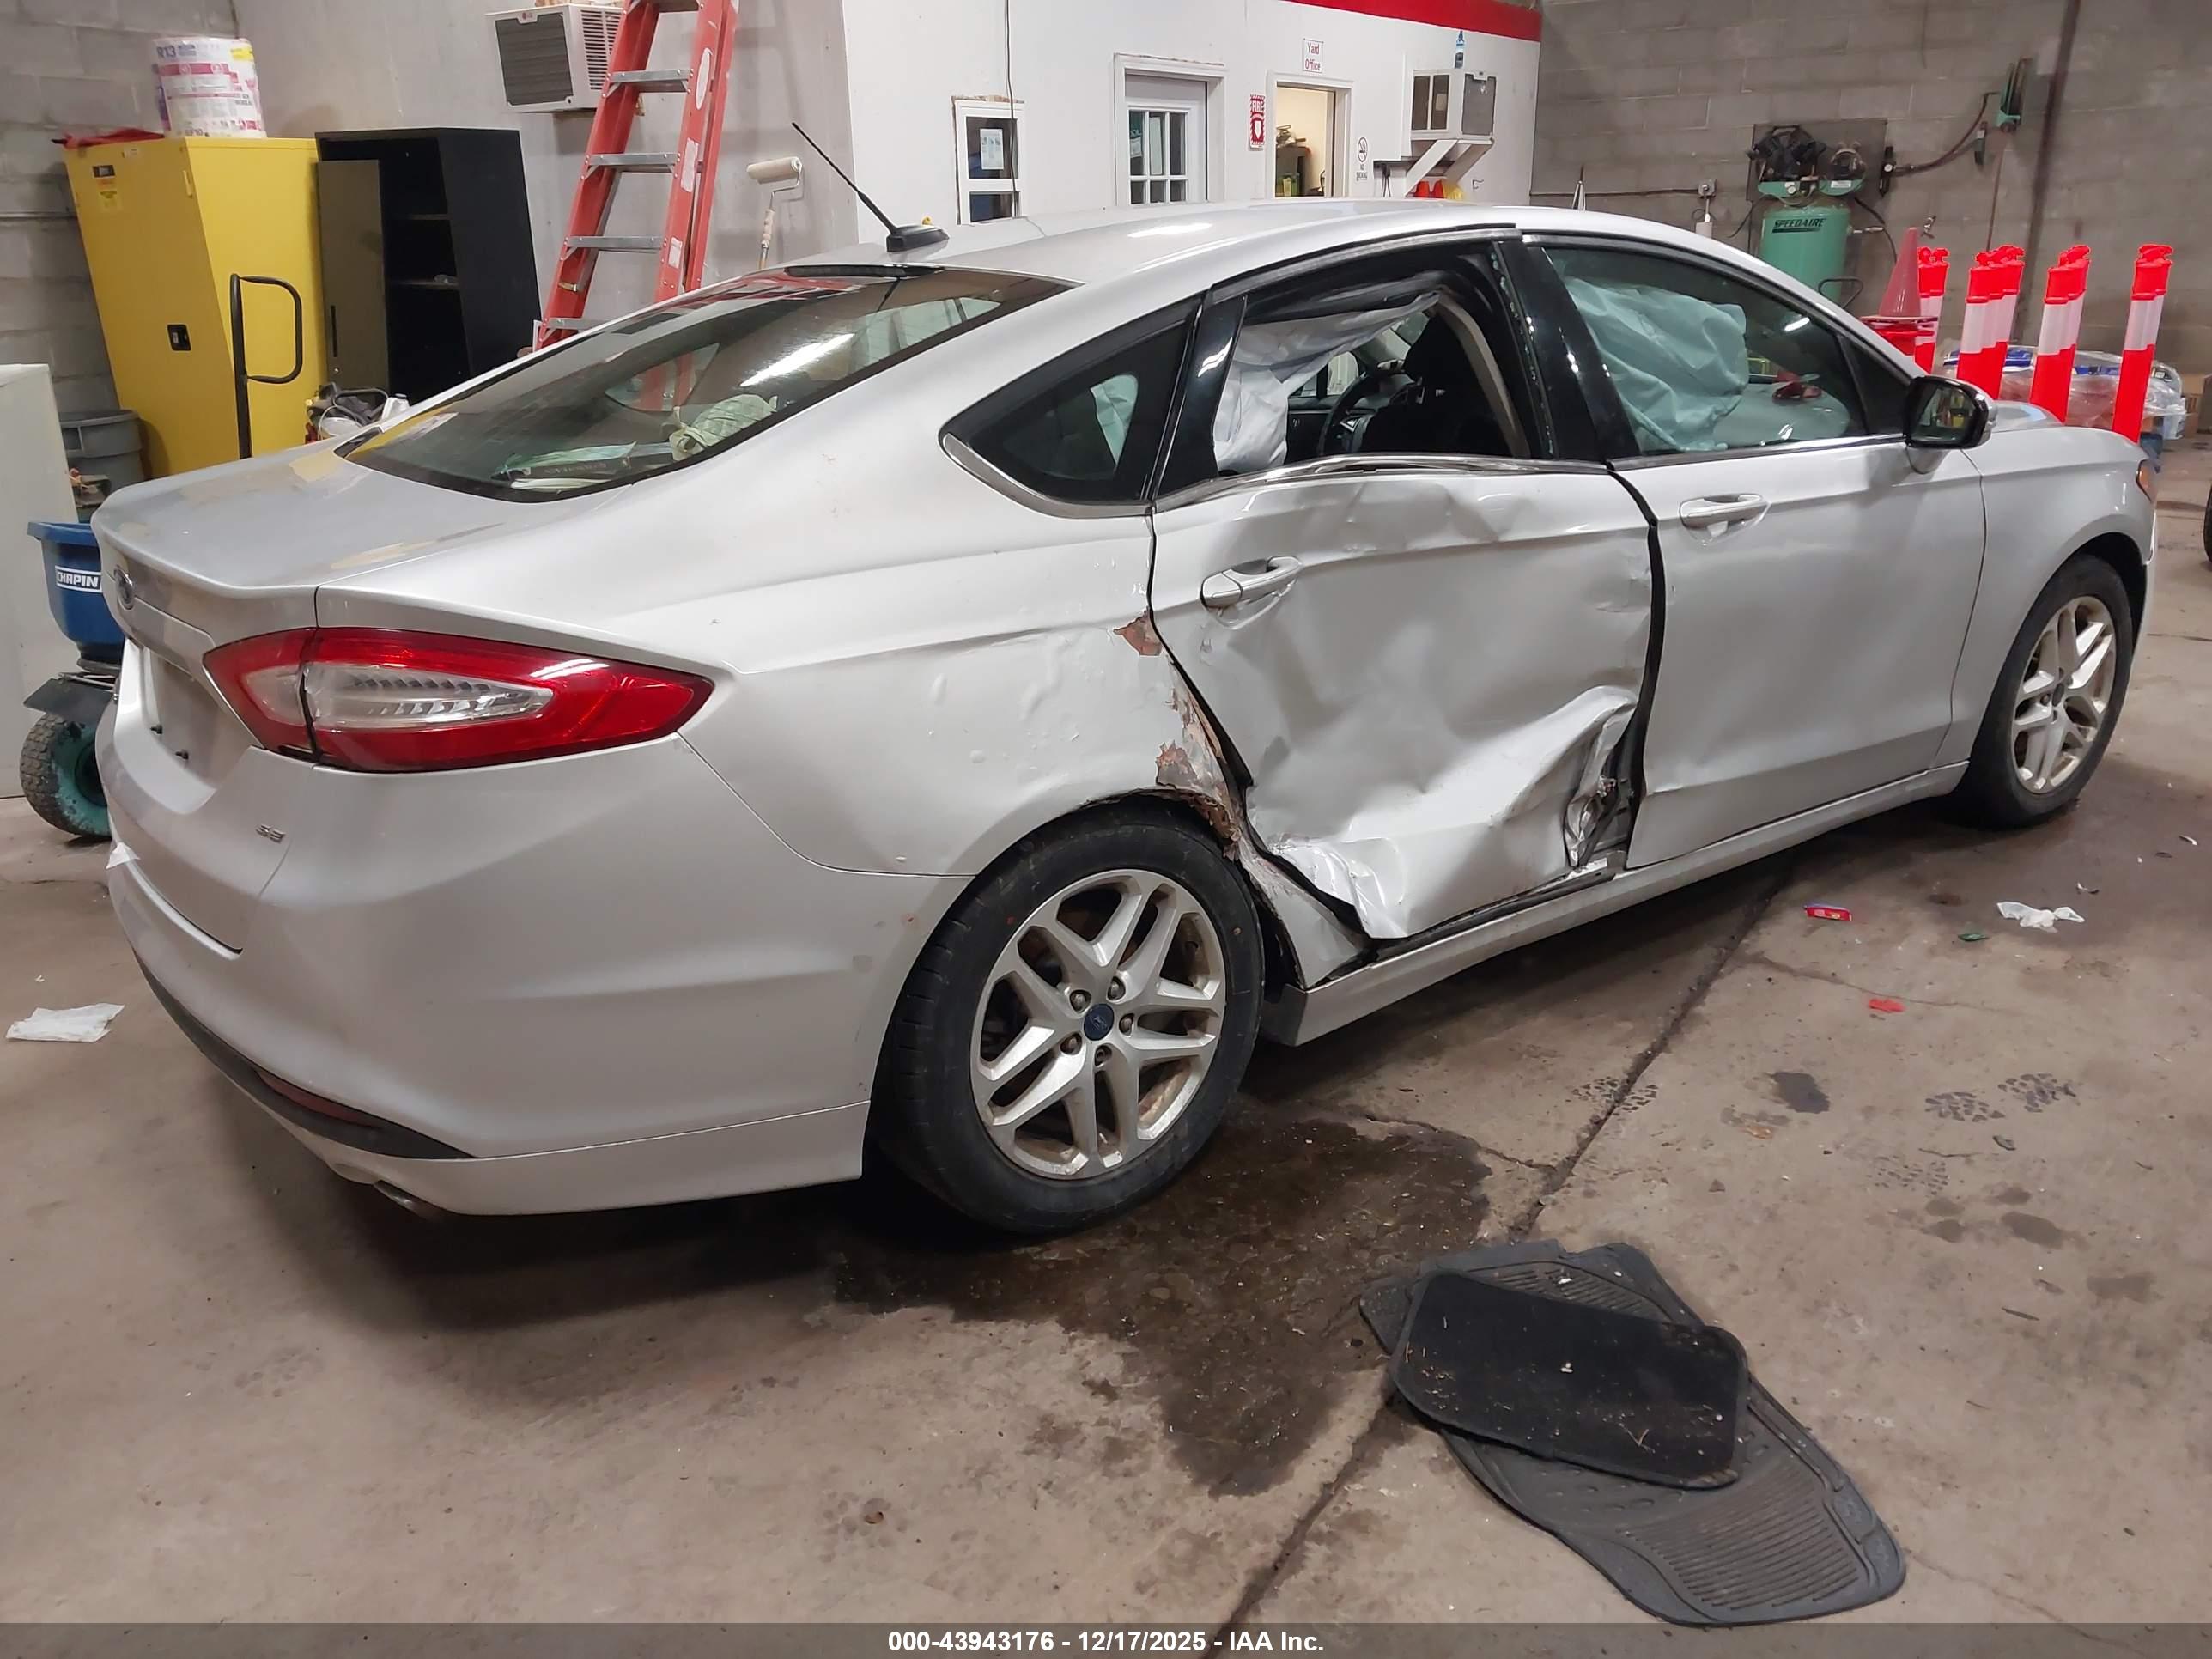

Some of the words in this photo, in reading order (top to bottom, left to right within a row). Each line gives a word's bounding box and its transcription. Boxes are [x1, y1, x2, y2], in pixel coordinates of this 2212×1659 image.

[156, 46, 177, 58] R13
[1307, 42, 1320, 55] Yard
[1304, 58, 1321, 71] Office
[1252, 100, 1263, 112] FIRE
[1773, 218, 1826, 228] SPEEDAIRE
[57, 571, 99, 588] CHAPIN
